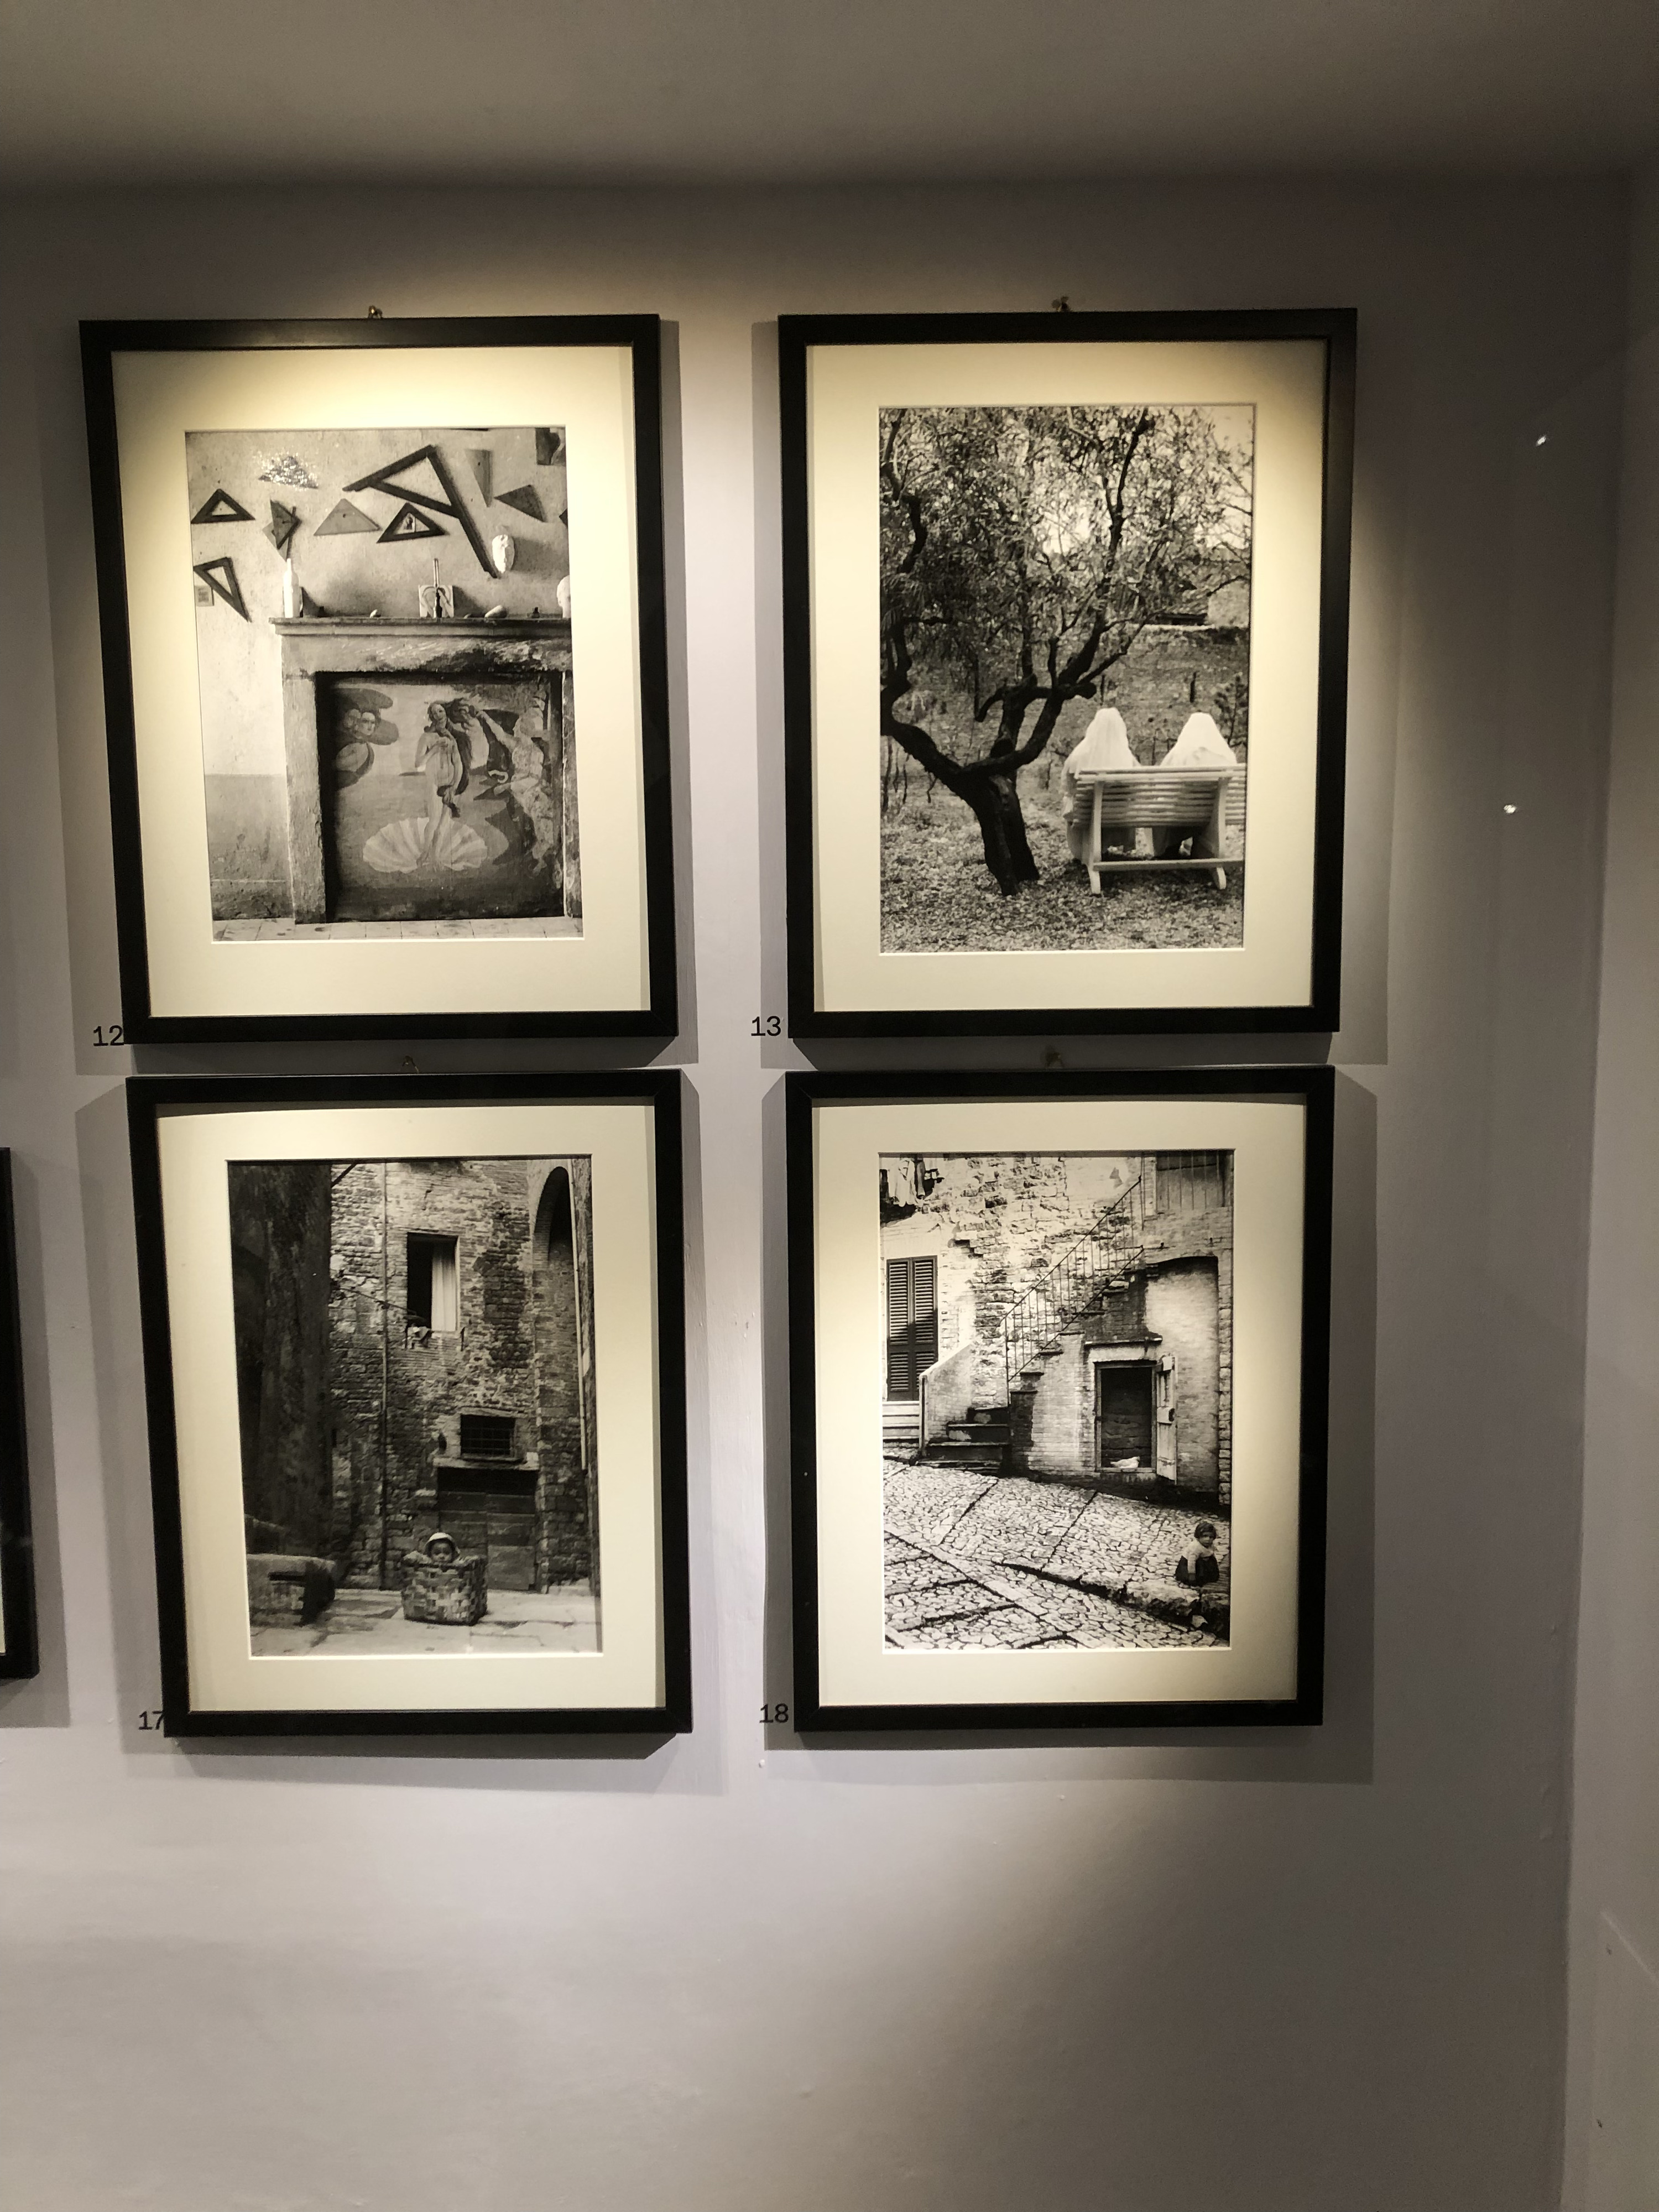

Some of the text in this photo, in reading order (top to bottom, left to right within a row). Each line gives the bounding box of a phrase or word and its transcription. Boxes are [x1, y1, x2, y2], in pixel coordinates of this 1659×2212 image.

[93, 1025, 124, 1046] 12
[751, 1015, 781, 1036] 13
[139, 1710, 164, 1730] 17
[759, 1703, 789, 1723] 18
